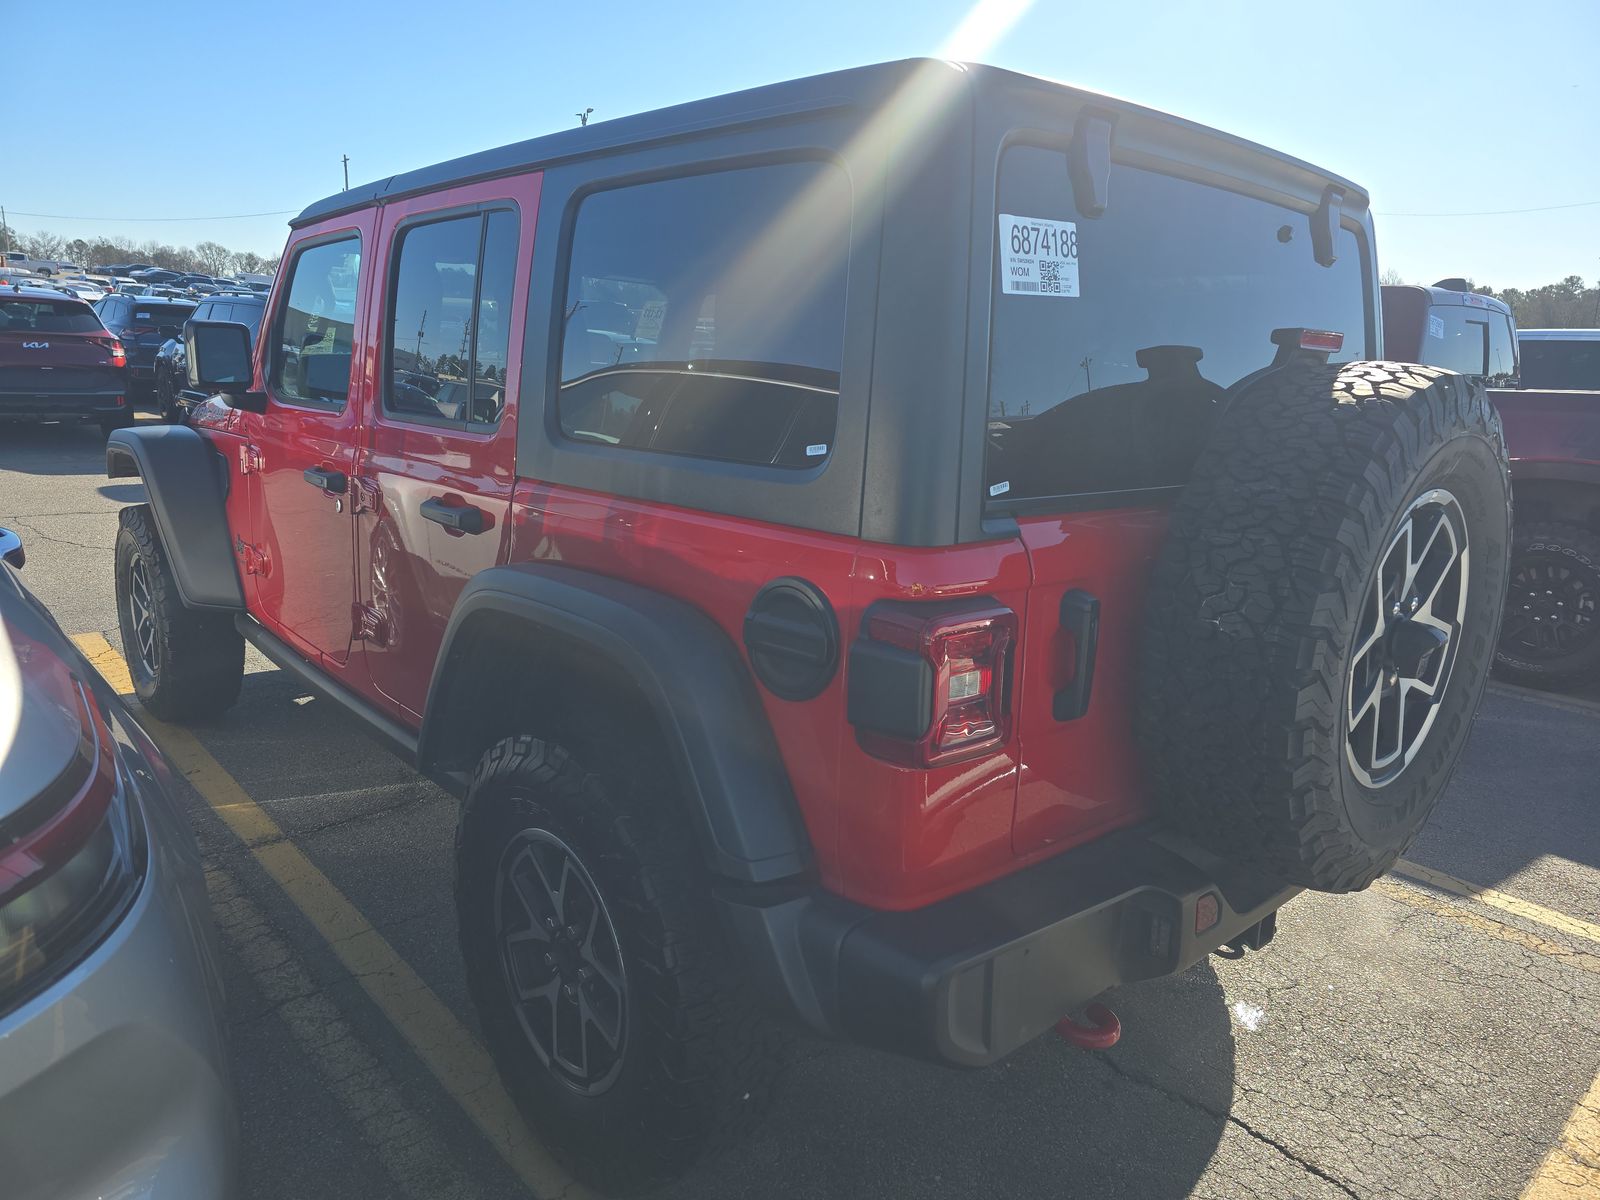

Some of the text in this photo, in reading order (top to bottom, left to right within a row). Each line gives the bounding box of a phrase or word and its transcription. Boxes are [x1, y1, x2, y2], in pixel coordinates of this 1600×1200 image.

[1011, 223, 1078, 259] 6874188
[1010, 266, 1030, 277] WOM
[22, 341, 49, 349] KIA
